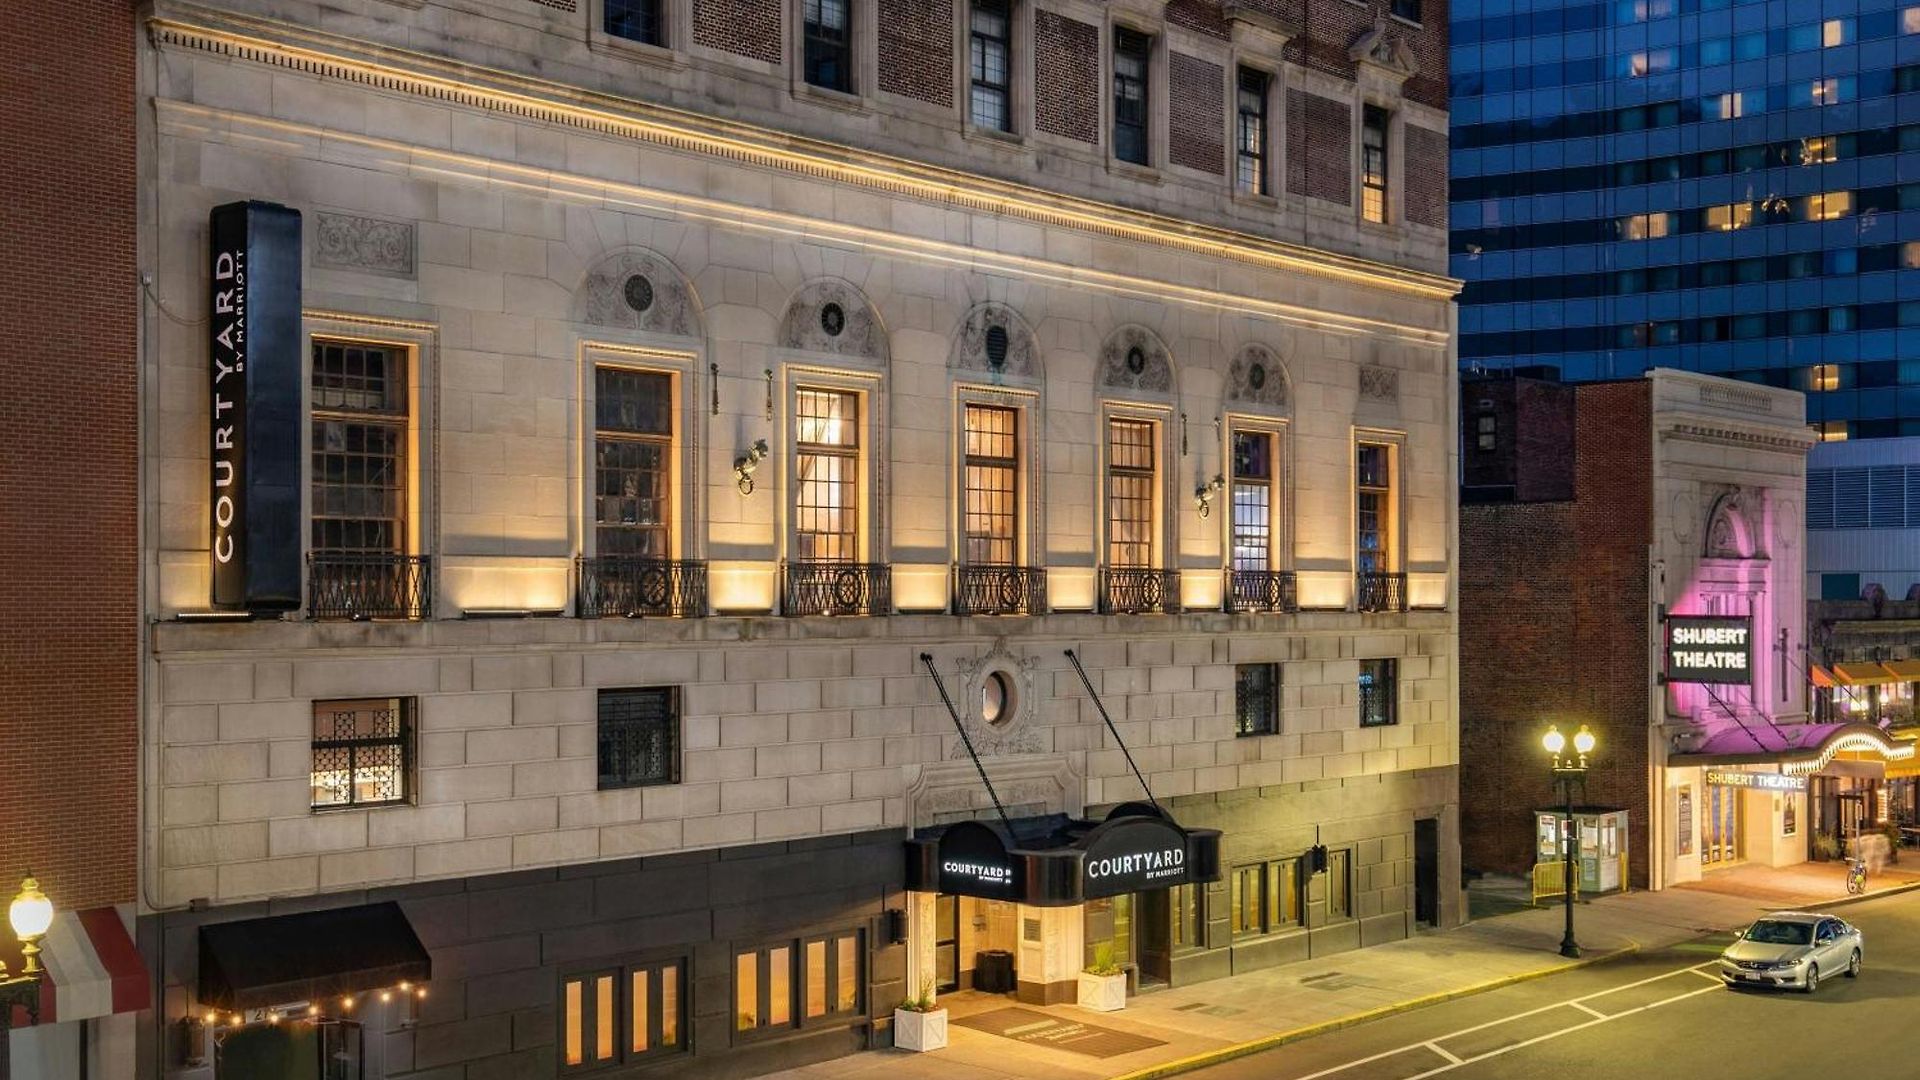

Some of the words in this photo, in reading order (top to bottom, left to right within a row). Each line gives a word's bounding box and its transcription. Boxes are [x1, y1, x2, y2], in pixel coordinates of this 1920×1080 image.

[236, 250, 244, 342] MARRIOTT
[236, 351, 244, 372] BY
[215, 252, 234, 564] COURTYARD
[1673, 628, 1747, 644] SHUBERT
[1673, 651, 1747, 668] THEATRE
[1707, 772, 1753, 785] SHUBERT
[1757, 775, 1805, 789] THEATRE
[944, 861, 1004, 877] COURTYARD
[1088, 849, 1184, 878] COURTYARD
[1146, 871, 1155, 879] BY
